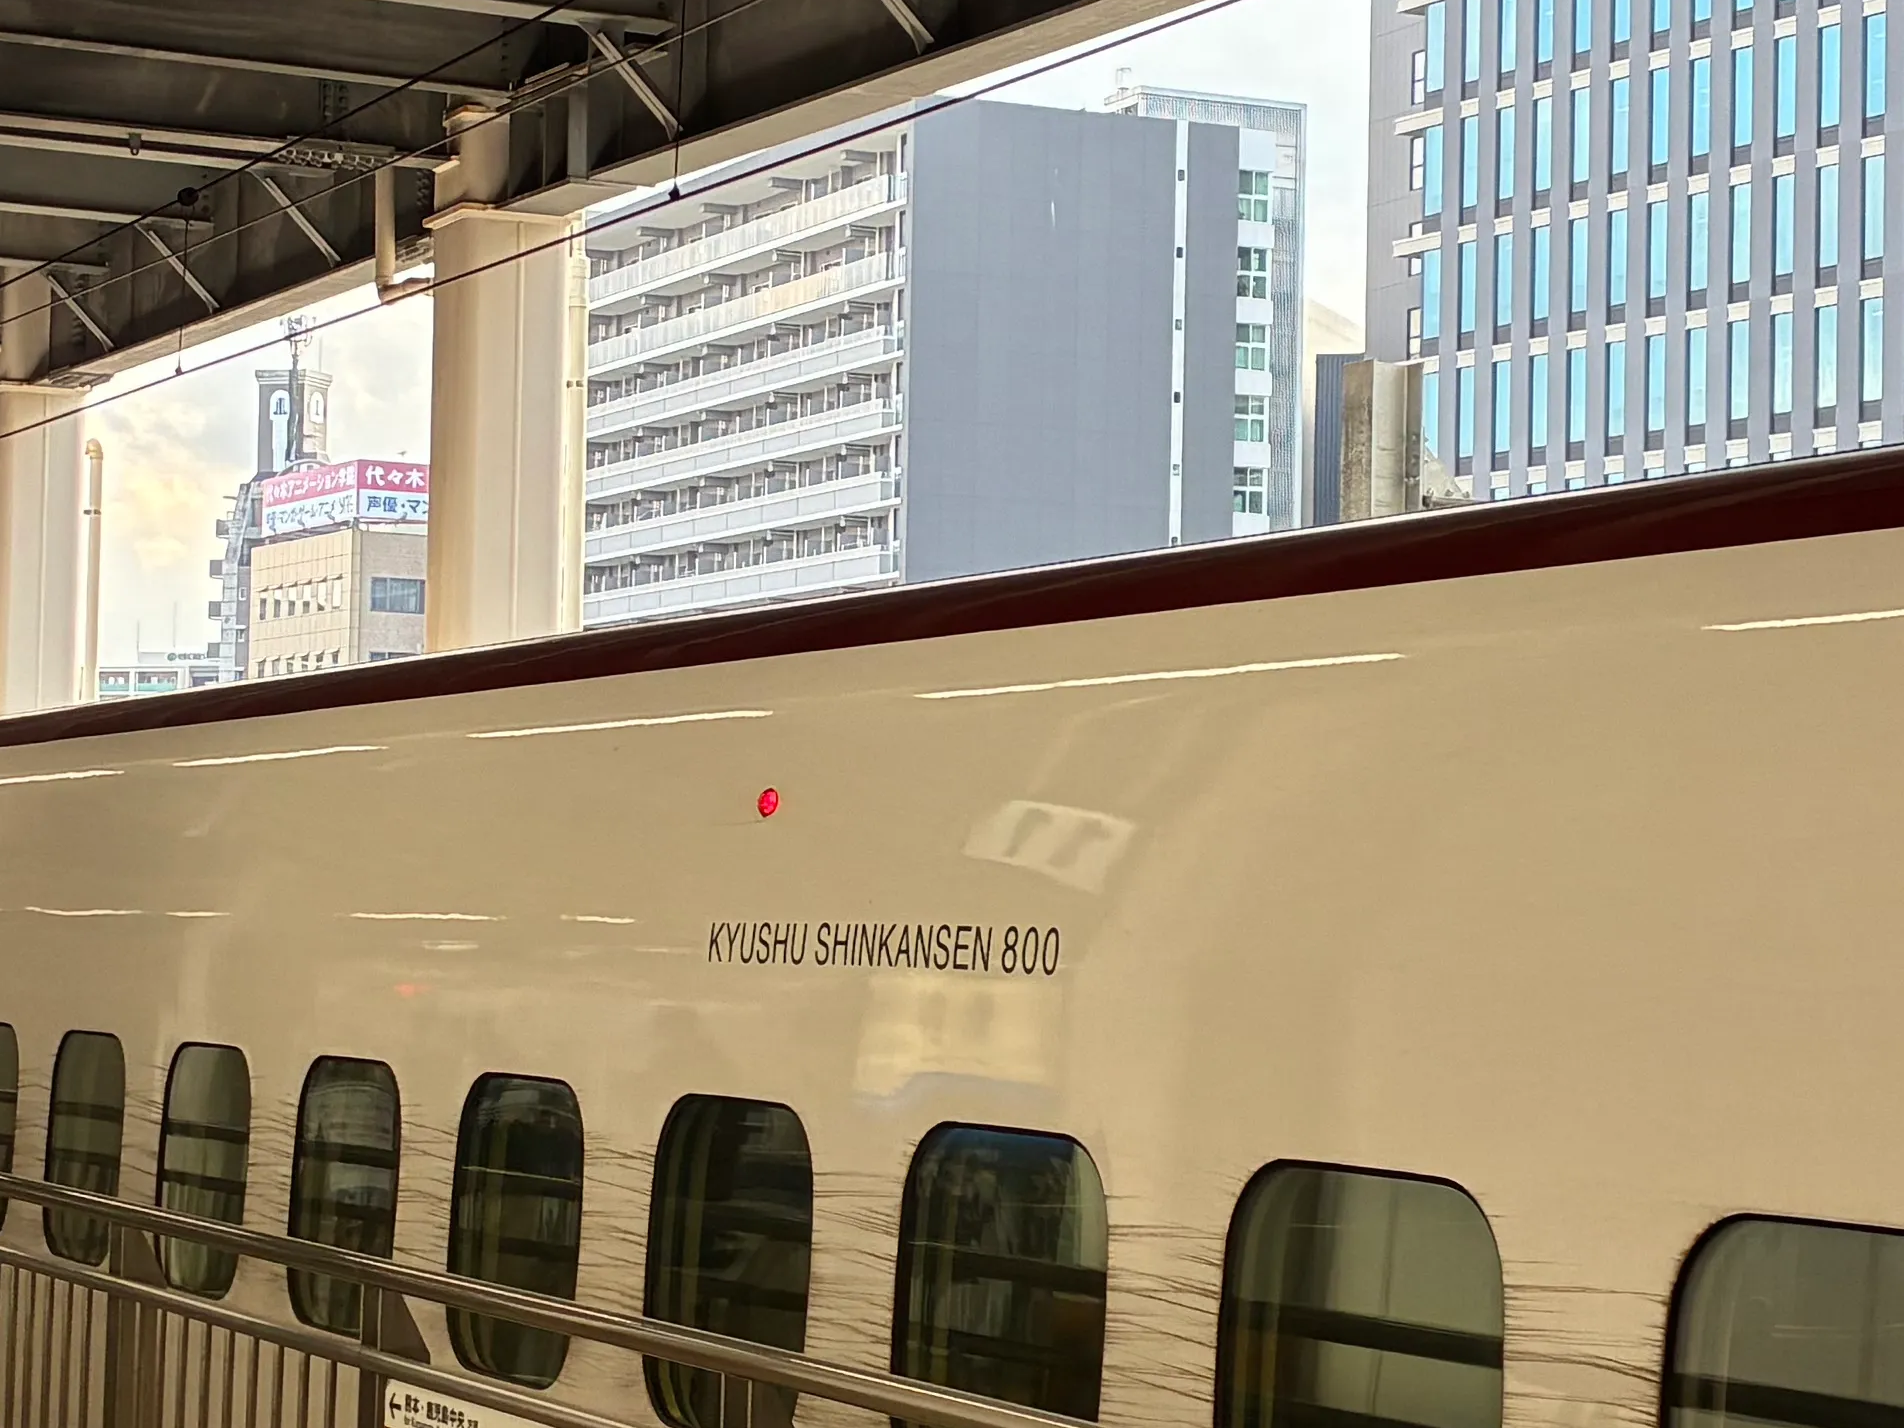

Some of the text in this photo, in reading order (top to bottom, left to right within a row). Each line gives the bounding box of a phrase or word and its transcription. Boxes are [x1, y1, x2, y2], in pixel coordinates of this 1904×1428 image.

[365, 464, 426, 489] 代々木
[708, 922, 1060, 976] KYUSHU SHINKANSEN 800
